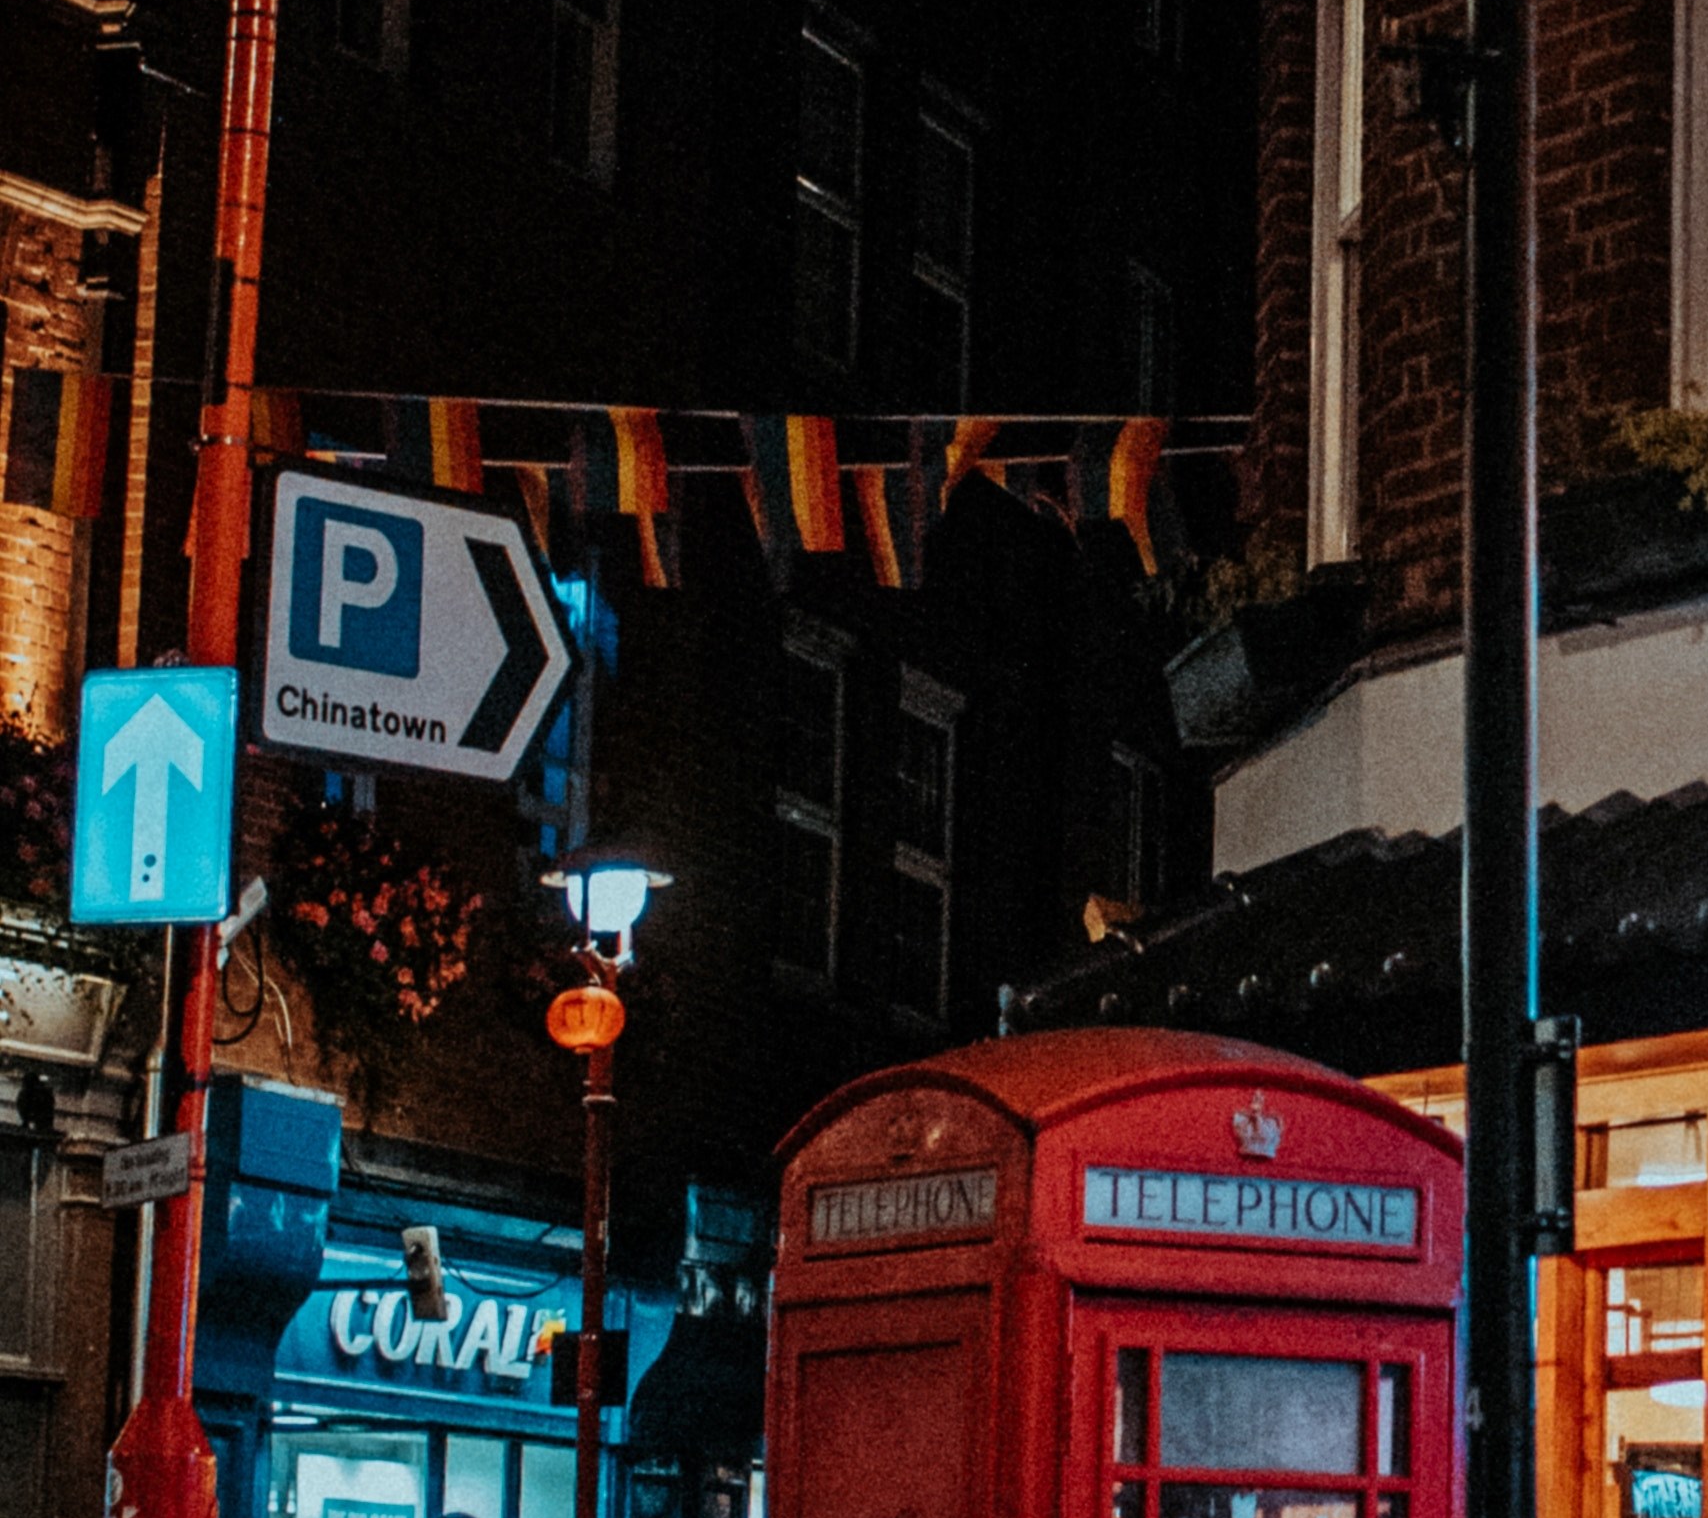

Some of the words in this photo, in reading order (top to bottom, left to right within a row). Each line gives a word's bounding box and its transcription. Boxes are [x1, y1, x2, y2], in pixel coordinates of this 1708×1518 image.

[318, 517, 399, 649] P
[277, 684, 447, 744] Chinatown
[820, 1173, 996, 1238] TELEPHONE
[1102, 1169, 1407, 1239] TELEPHONE
[330, 1288, 531, 1379] CORAL
